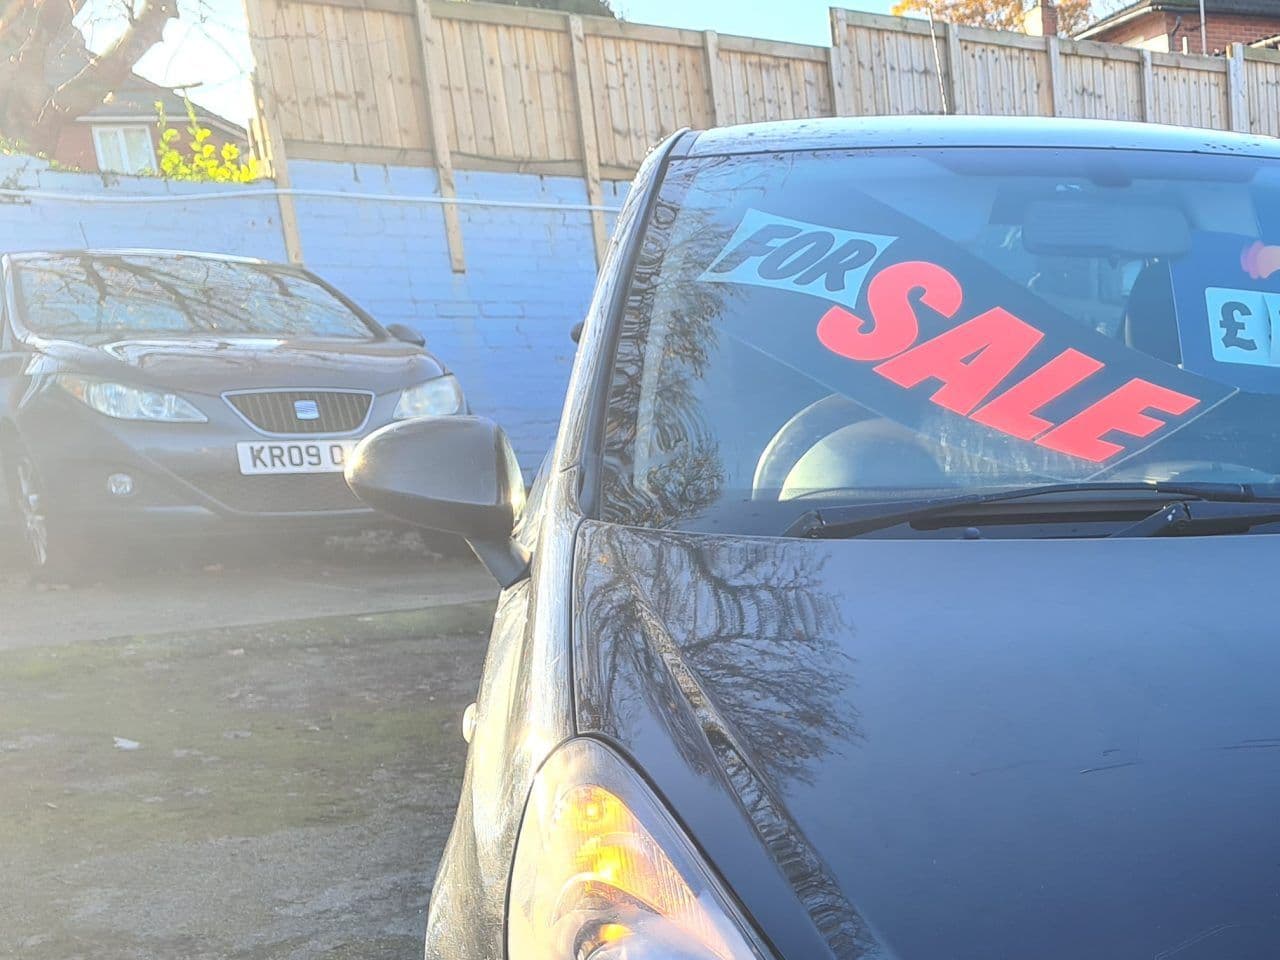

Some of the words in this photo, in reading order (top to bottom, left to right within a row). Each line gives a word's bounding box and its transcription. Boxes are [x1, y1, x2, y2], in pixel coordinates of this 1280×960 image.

[729, 223, 879, 294] FOR
[817, 261, 1201, 463] SALE
[249, 445, 322, 468] KR09
